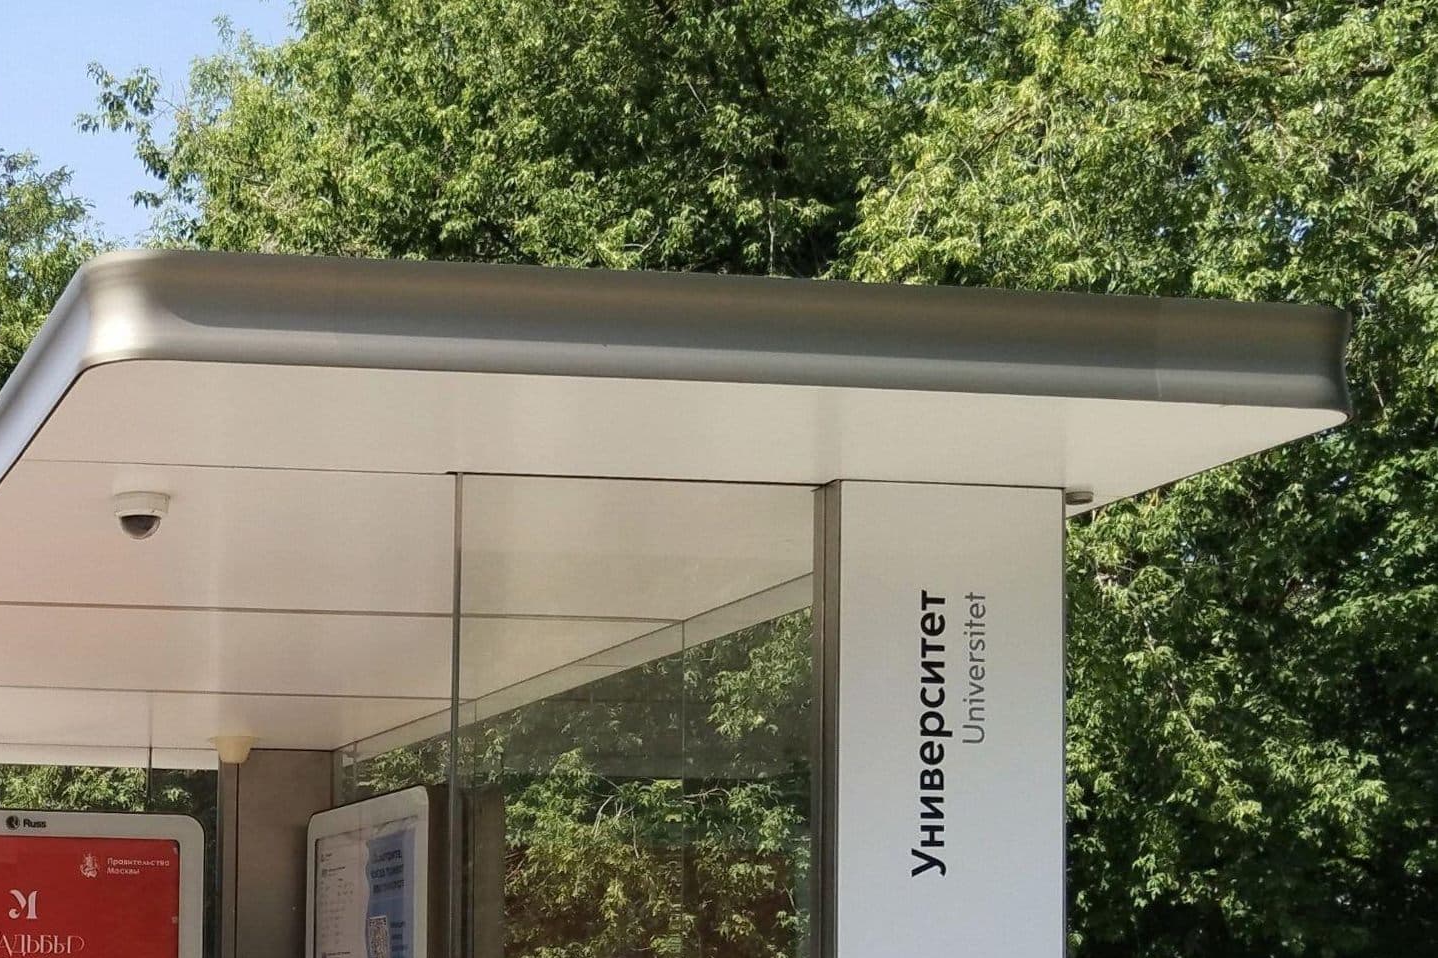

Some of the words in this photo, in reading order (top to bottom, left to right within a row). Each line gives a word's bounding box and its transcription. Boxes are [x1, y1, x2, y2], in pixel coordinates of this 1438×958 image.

[962, 591, 987, 744] Universitet
[911, 589, 953, 877] Университет
[23, 818, 47, 829] Russ
[107, 857, 170, 867] Правительство
